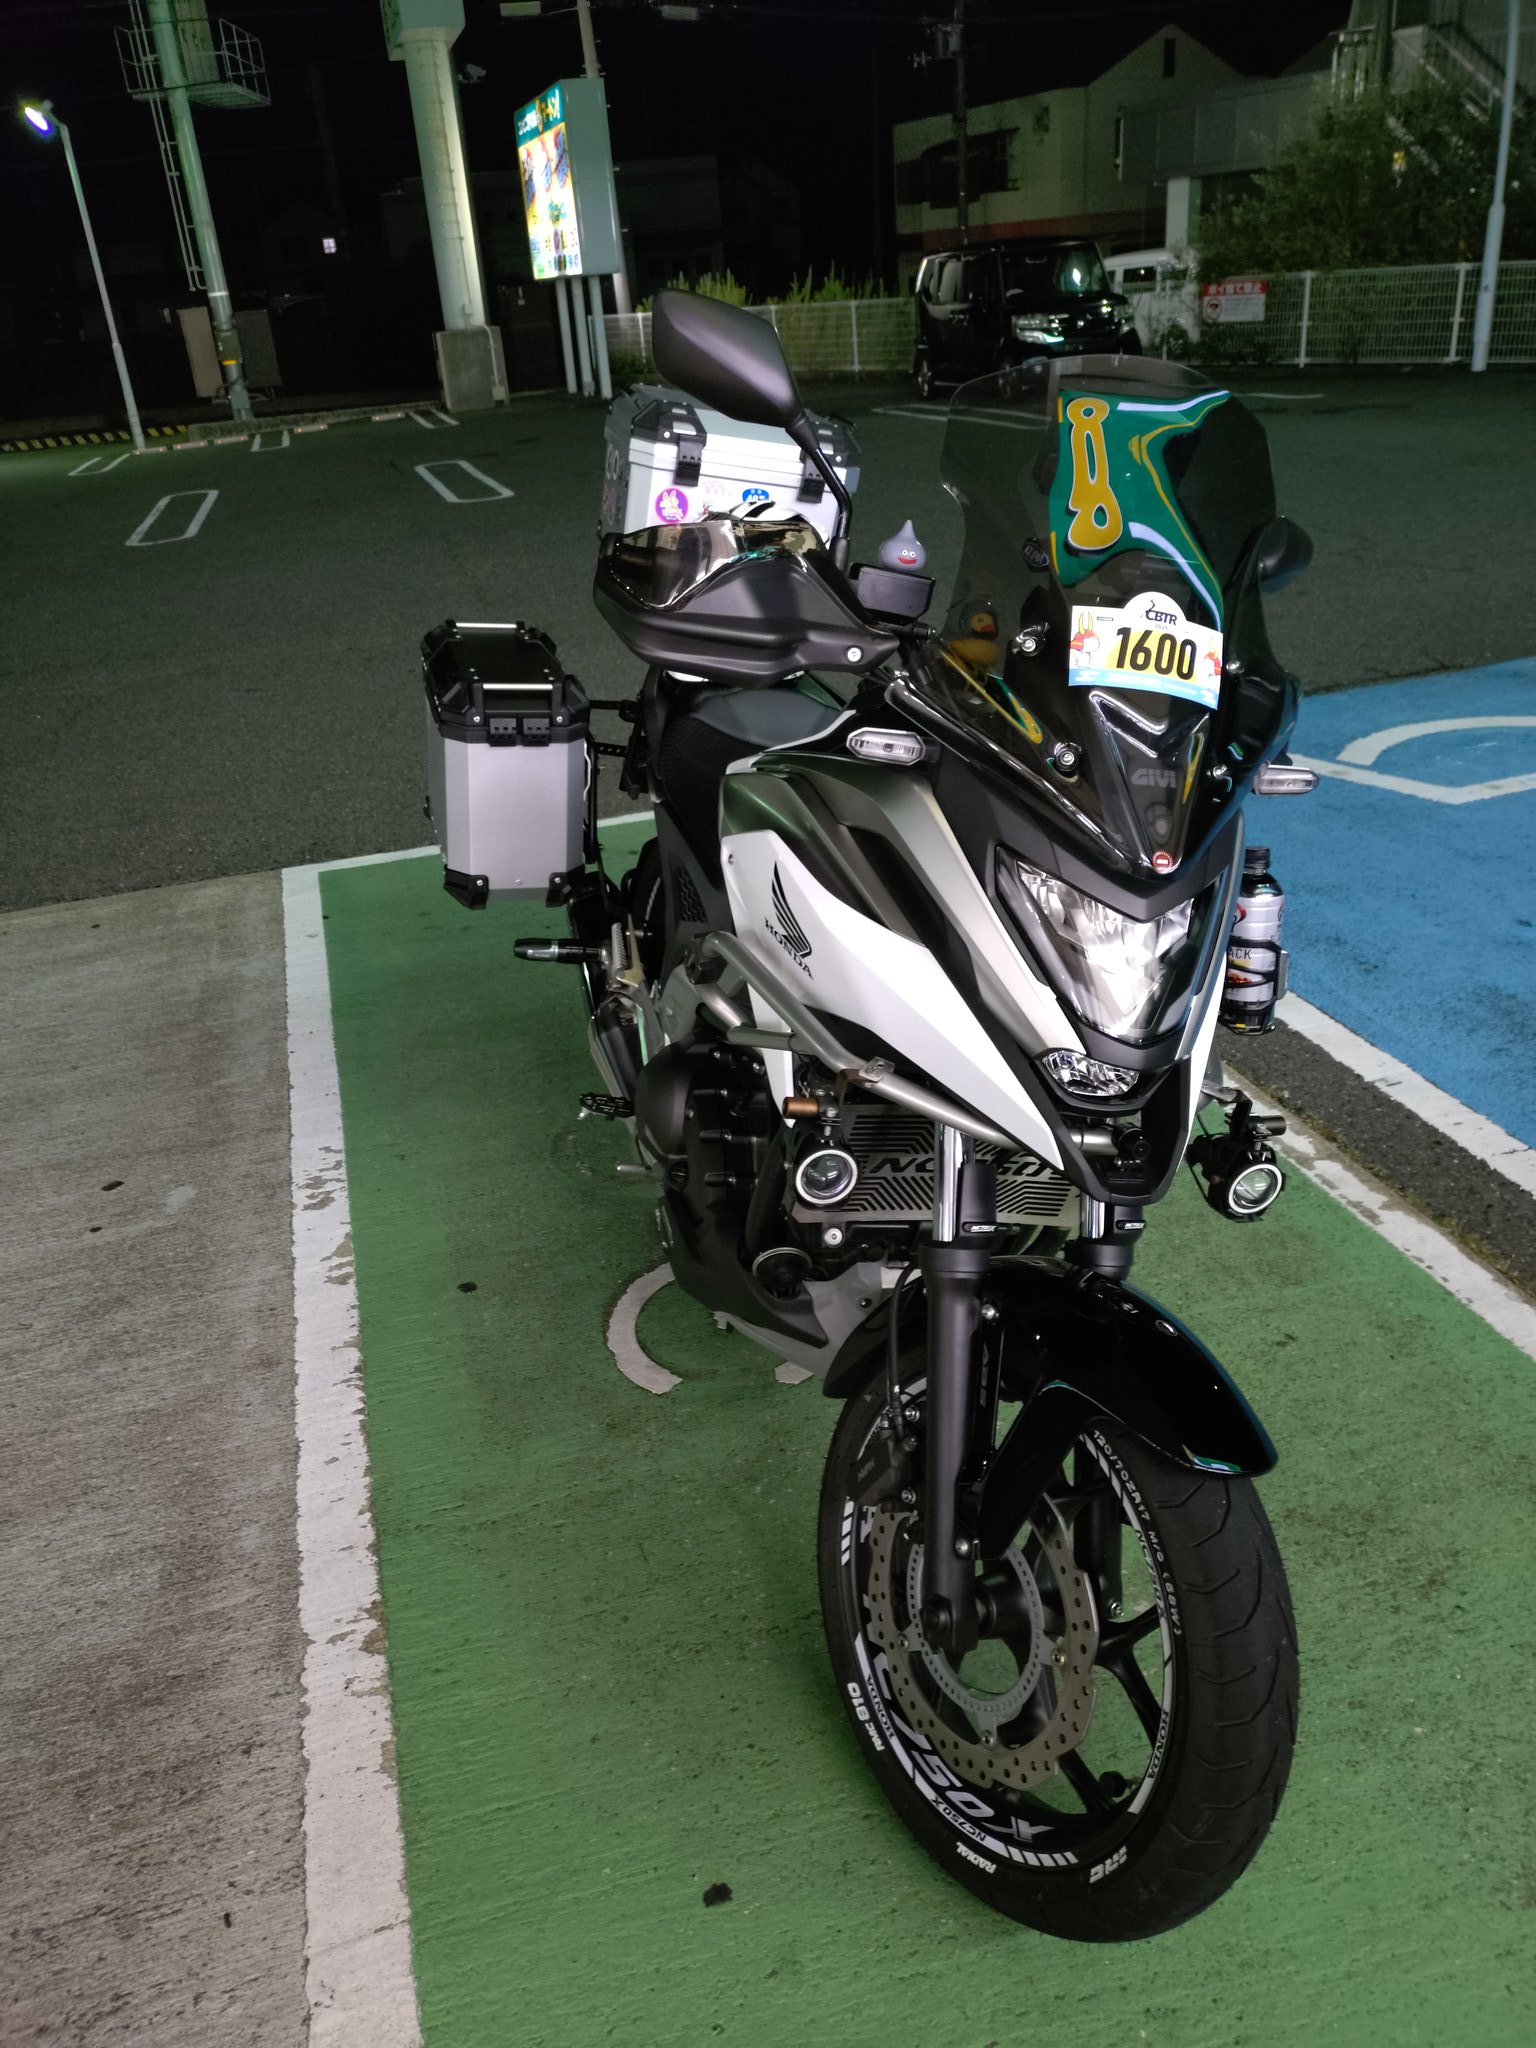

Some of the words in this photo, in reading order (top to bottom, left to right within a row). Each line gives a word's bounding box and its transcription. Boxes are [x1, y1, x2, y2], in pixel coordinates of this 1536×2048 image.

[1145, 603, 1178, 626] CBTR
[1116, 627, 1197, 680] 1600
[1131, 768, 1177, 788] GIVI
[764, 917, 814, 980] HONDA
[847, 1682, 870, 1722] 810
[867, 1673, 895, 1739] HONDA
[865, 1722, 885, 1751] RMC
[1147, 1711, 1169, 1780] HONDA
[932, 1796, 986, 1843] NC750X
[956, 1841, 997, 1875] RADIAL
